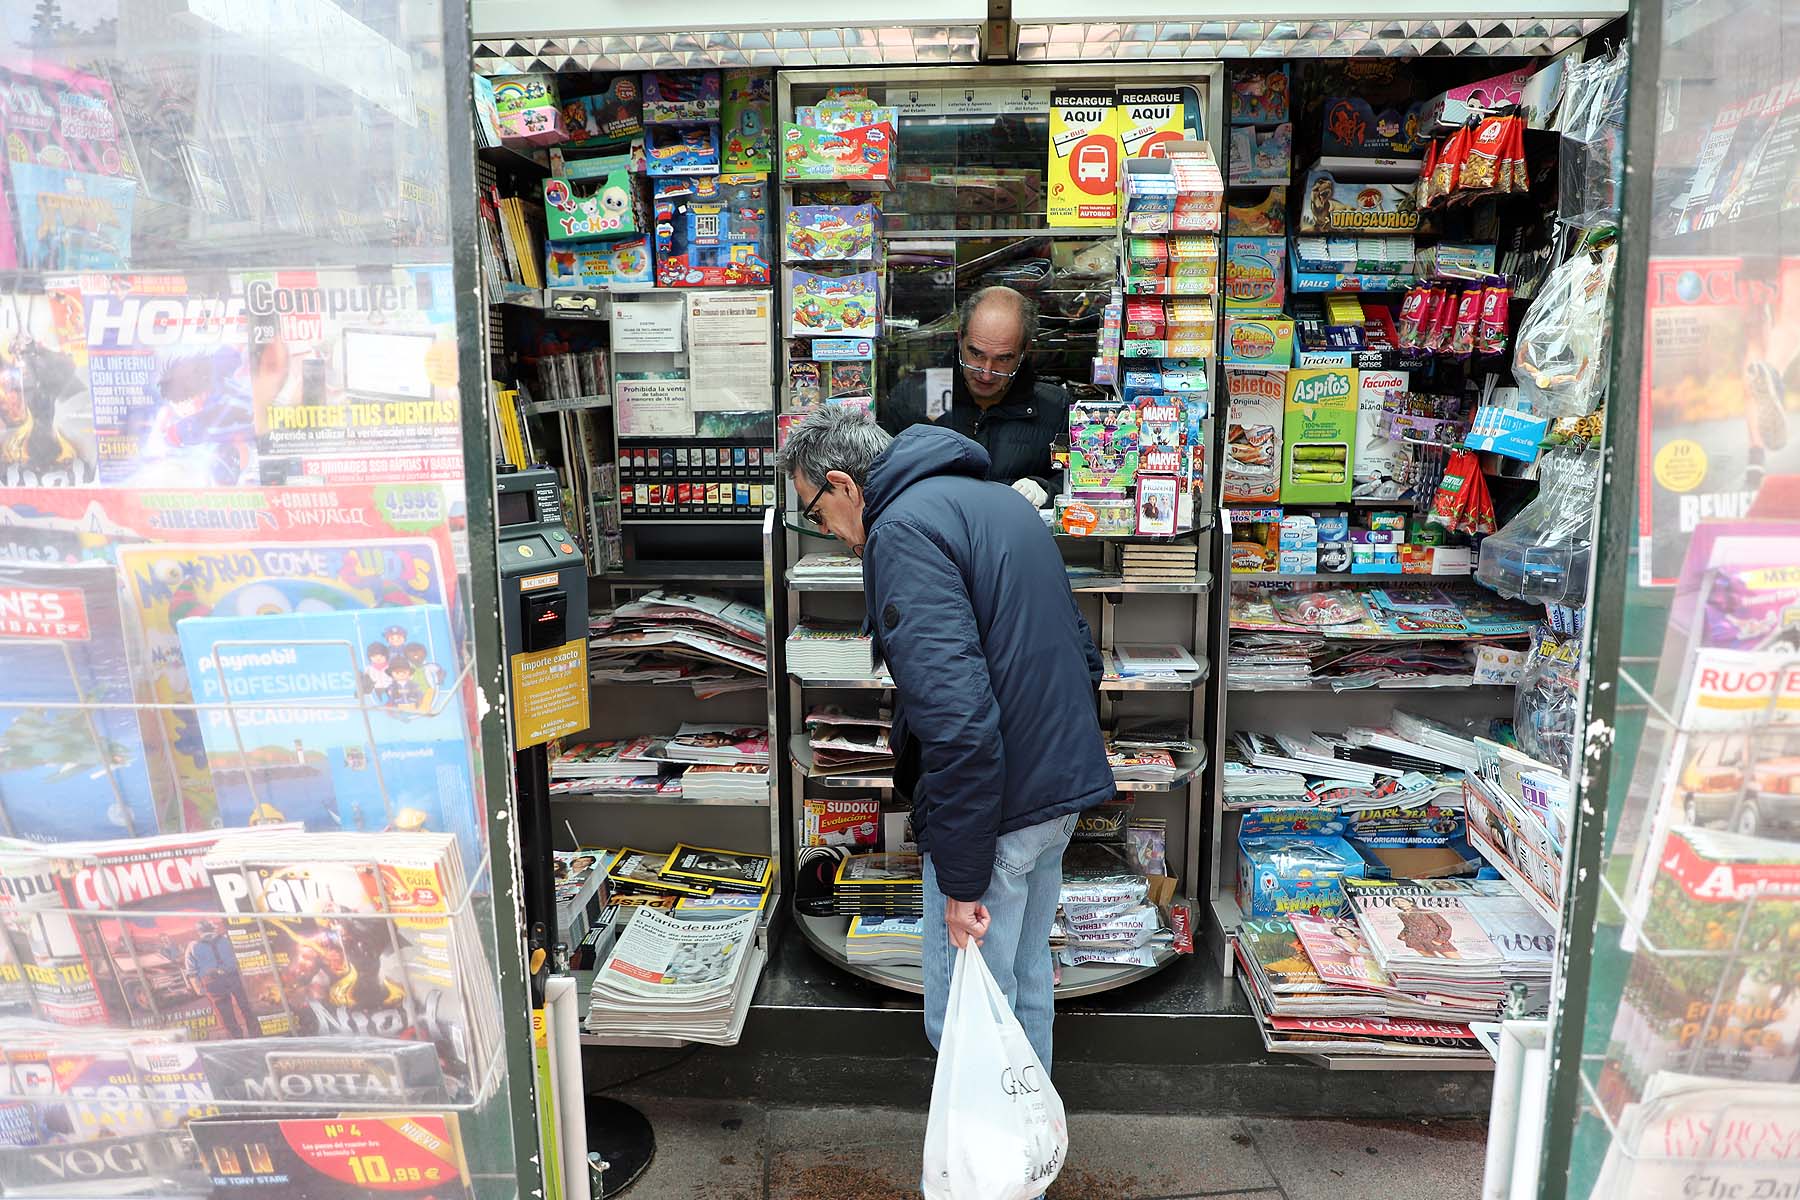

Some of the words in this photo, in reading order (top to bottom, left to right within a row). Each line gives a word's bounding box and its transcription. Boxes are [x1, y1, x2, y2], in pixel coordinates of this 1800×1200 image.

[1055, 97, 1113, 106] RECARGUE
[1123, 94, 1180, 103] RECARGUE
[1064, 109, 1103, 122] AQUÍ
[1132, 105, 1171, 119] AQUÍ
[1070, 128, 1086, 139] BUS
[1138, 125, 1154, 136] BUS
[1179, 217, 1207, 225] HALLS
[1332, 212, 1418, 228] DINOSAURIOS
[1177, 282, 1203, 290] HALLS
[249, 279, 412, 319] Computer
[281, 315, 323, 343] Hoy
[1303, 356, 1345, 365] Trident
[1359, 353, 1383, 361] senses
[1399, 359, 1423, 367] senses
[92, 372, 115, 385] CON
[1362, 376, 1403, 389] facundo
[1294, 373, 1350, 402] Aspitos
[265, 404, 348, 428] ¡PROTEGE
[352, 403, 384, 426] TUS
[385, 400, 459, 424] CUENTAS!
[1143, 407, 1178, 421] MARVEL
[269, 430, 306, 442] Aprende
[315, 429, 346, 441] utilizar
[358, 427, 405, 439] verificación
[1510, 436, 1528, 446] unicef
[1148, 453, 1180, 465] MARVEL
[1319, 522, 1343, 530] HALLS
[1366, 533, 1389, 541] Orbit
[264, 551, 329, 577] COME
[1320, 554, 1347, 562] HALLS
[1250, 581, 1293, 589] SABER
[199, 648, 297, 673] playmobil
[521, 657, 552, 672] Importe
[553, 650, 578, 662] exacto
[203, 672, 355, 697] PROFESIONES
[1700, 667, 1800, 693] RUOTE
[826, 801, 878, 814] SUDOKU
[821, 813, 867, 828] Evolución
[1360, 809, 1401, 821] DARK
[1403, 808, 1427, 819] SEA
[1066, 895, 1100, 903] ETERNAS
[639, 909, 680, 931] Diario
[682, 923, 699, 931] de
[702, 917, 750, 931] Burgos
[1070, 912, 1097, 921] TERNAS
[1686, 1001, 1787, 1026] Enrique
[1297, 1019, 1367, 1031] MODA
[1369, 1022, 1464, 1035] ESTRENA
[1679, 1022, 1784, 1052] Ponce
[350, 1124, 362, 1136] 4
[400, 1122, 441, 1151] NUEVO
[229, 1175, 255, 1185] TONY
[257, 1174, 289, 1184] STARK
[424, 1168, 442, 1181] €
